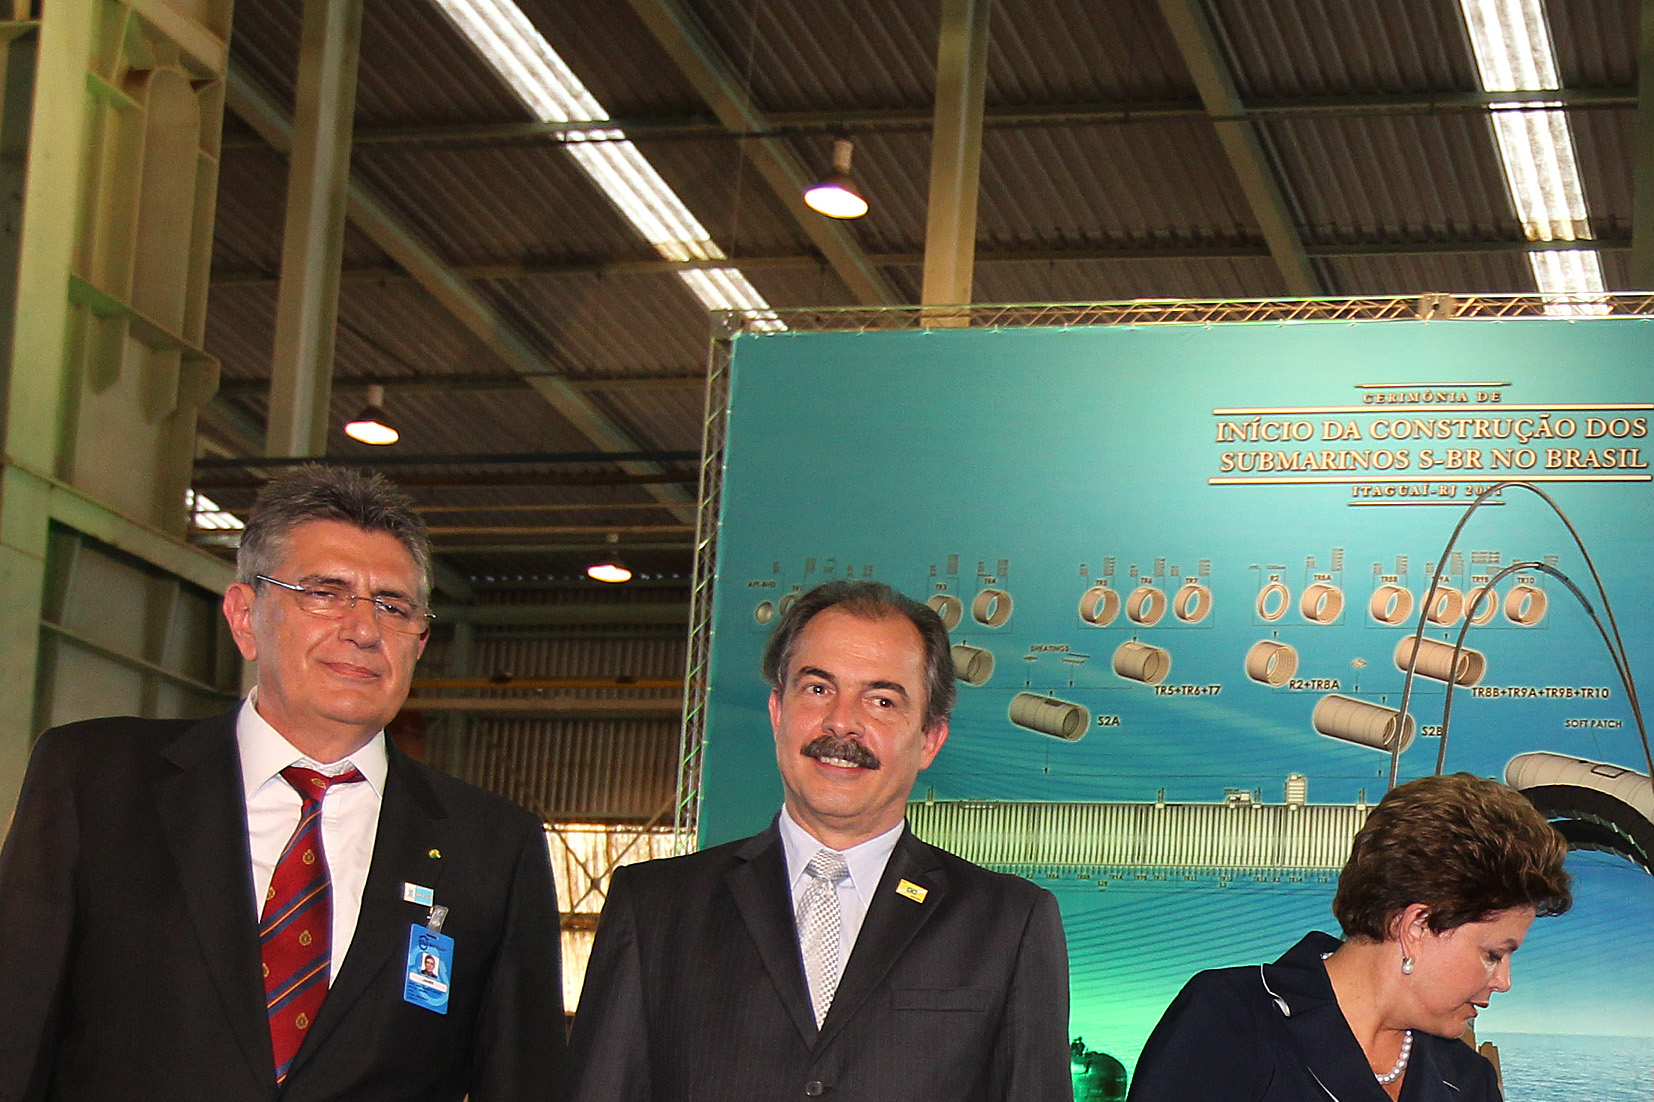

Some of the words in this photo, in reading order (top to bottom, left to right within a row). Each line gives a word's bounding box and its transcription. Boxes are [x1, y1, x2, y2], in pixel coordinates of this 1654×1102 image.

[1363, 390, 1468, 403] CERIMÔNIA
[1477, 391, 1501, 402] DE
[1216, 416, 1314, 442] INÍCIO
[1321, 420, 1362, 441] DA
[1369, 413, 1577, 443] CONSTRUÇÃO
[1585, 417, 1648, 438] DOS
[1220, 449, 1410, 472] SUBMARINOS
[1418, 449, 1483, 470] S-BR
[1491, 449, 1537, 469] NO
[1545, 448, 1649, 469] BRASIL
[1352, 483, 1457, 497] ITAGUAÍ-RJ
[1289, 680, 1340, 690] R2+TR8A
[1154, 686, 1221, 696] TR5+TR6+T7
[1472, 687, 1609, 698] TR8B+TR9A+TR9B+TR10
[1098, 716, 1120, 726] S2A
[1565, 719, 1588, 728] SOFT
[1591, 720, 1622, 728] PATCH
